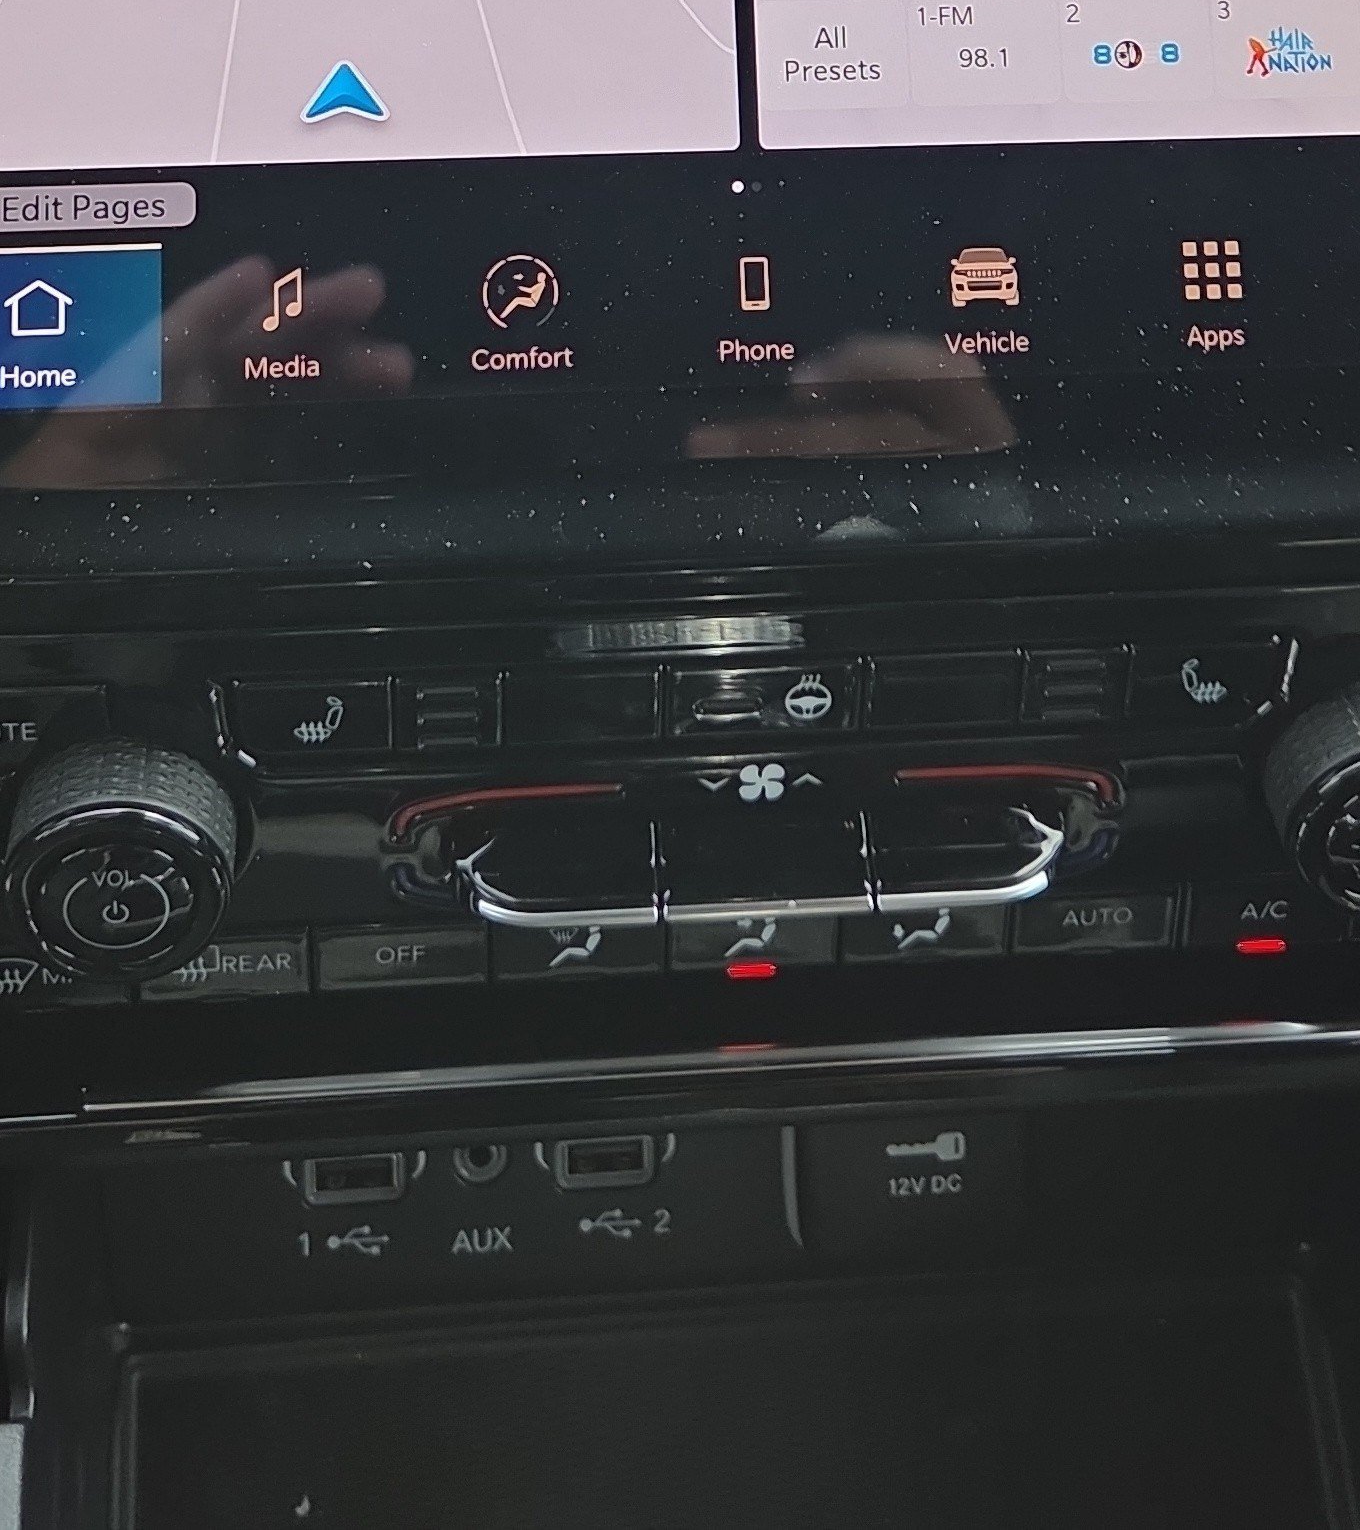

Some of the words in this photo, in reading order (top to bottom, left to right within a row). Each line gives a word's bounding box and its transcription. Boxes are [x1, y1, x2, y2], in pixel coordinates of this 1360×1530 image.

[916, 6, 974, 26] 1-FM
[1065, 3, 1081, 24] 2
[1217, 0, 1231, 20] 3
[814, 25, 848, 49] All
[958, 47, 1009, 69] 98.1
[1268, 50, 1333, 74] NATION
[784, 60, 882, 83] Presets
[0, 195, 65, 223] Edit
[72, 193, 167, 227] Pages
[944, 329, 1031, 357] Vehicle
[1186, 324, 1247, 351] Apps
[470, 345, 575, 373] Comfort
[718, 337, 797, 365] Phone
[0, 364, 78, 391] Home
[243, 354, 321, 380] Media
[91, 870, 133, 888] VOL
[1061, 905, 1133, 928] AUTO
[1241, 900, 1288, 922] A/C
[221, 953, 292, 973] REAR
[375, 943, 427, 965] OFF
[888, 1177, 926, 1196] 12V
[930, 1173, 962, 1195] DC
[654, 1210, 672, 1234] 2
[297, 1232, 311, 1257] 1
[451, 1225, 514, 1254] AUX
